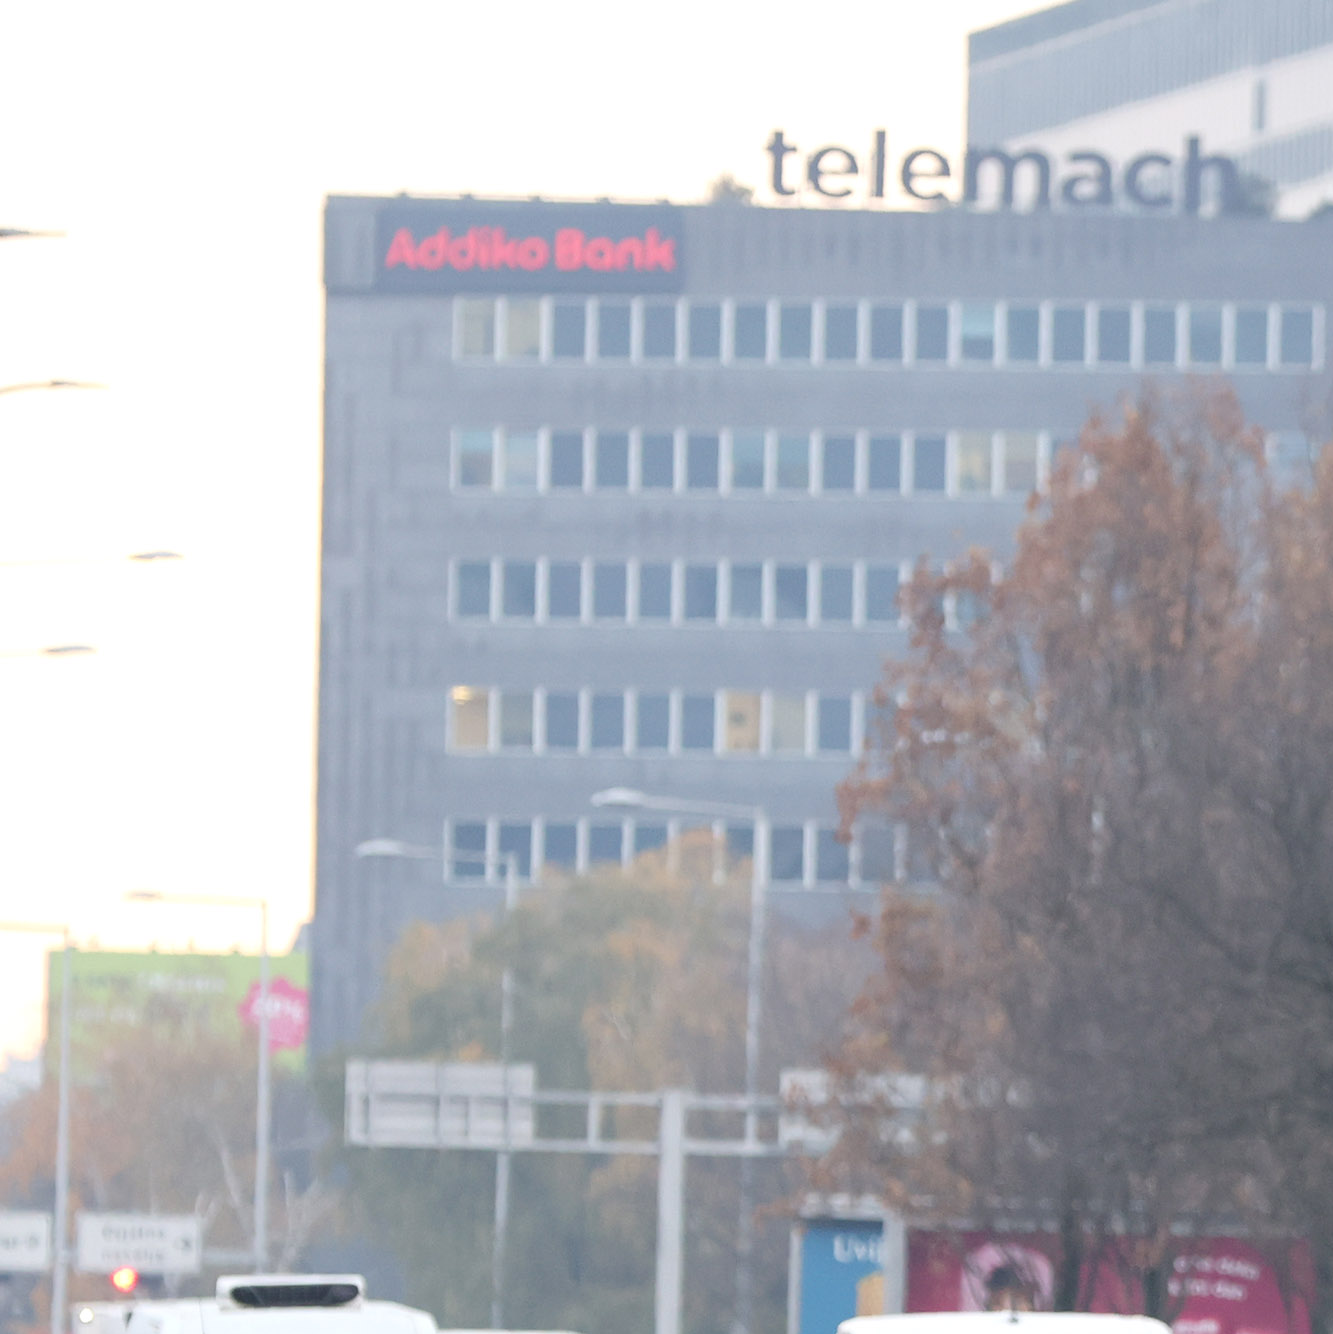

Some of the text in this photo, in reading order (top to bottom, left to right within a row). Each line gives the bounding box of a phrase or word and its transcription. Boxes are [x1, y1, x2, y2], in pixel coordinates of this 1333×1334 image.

[766, 129, 1243, 214] telemach
[384, 225, 677, 274] Addiko Bank
